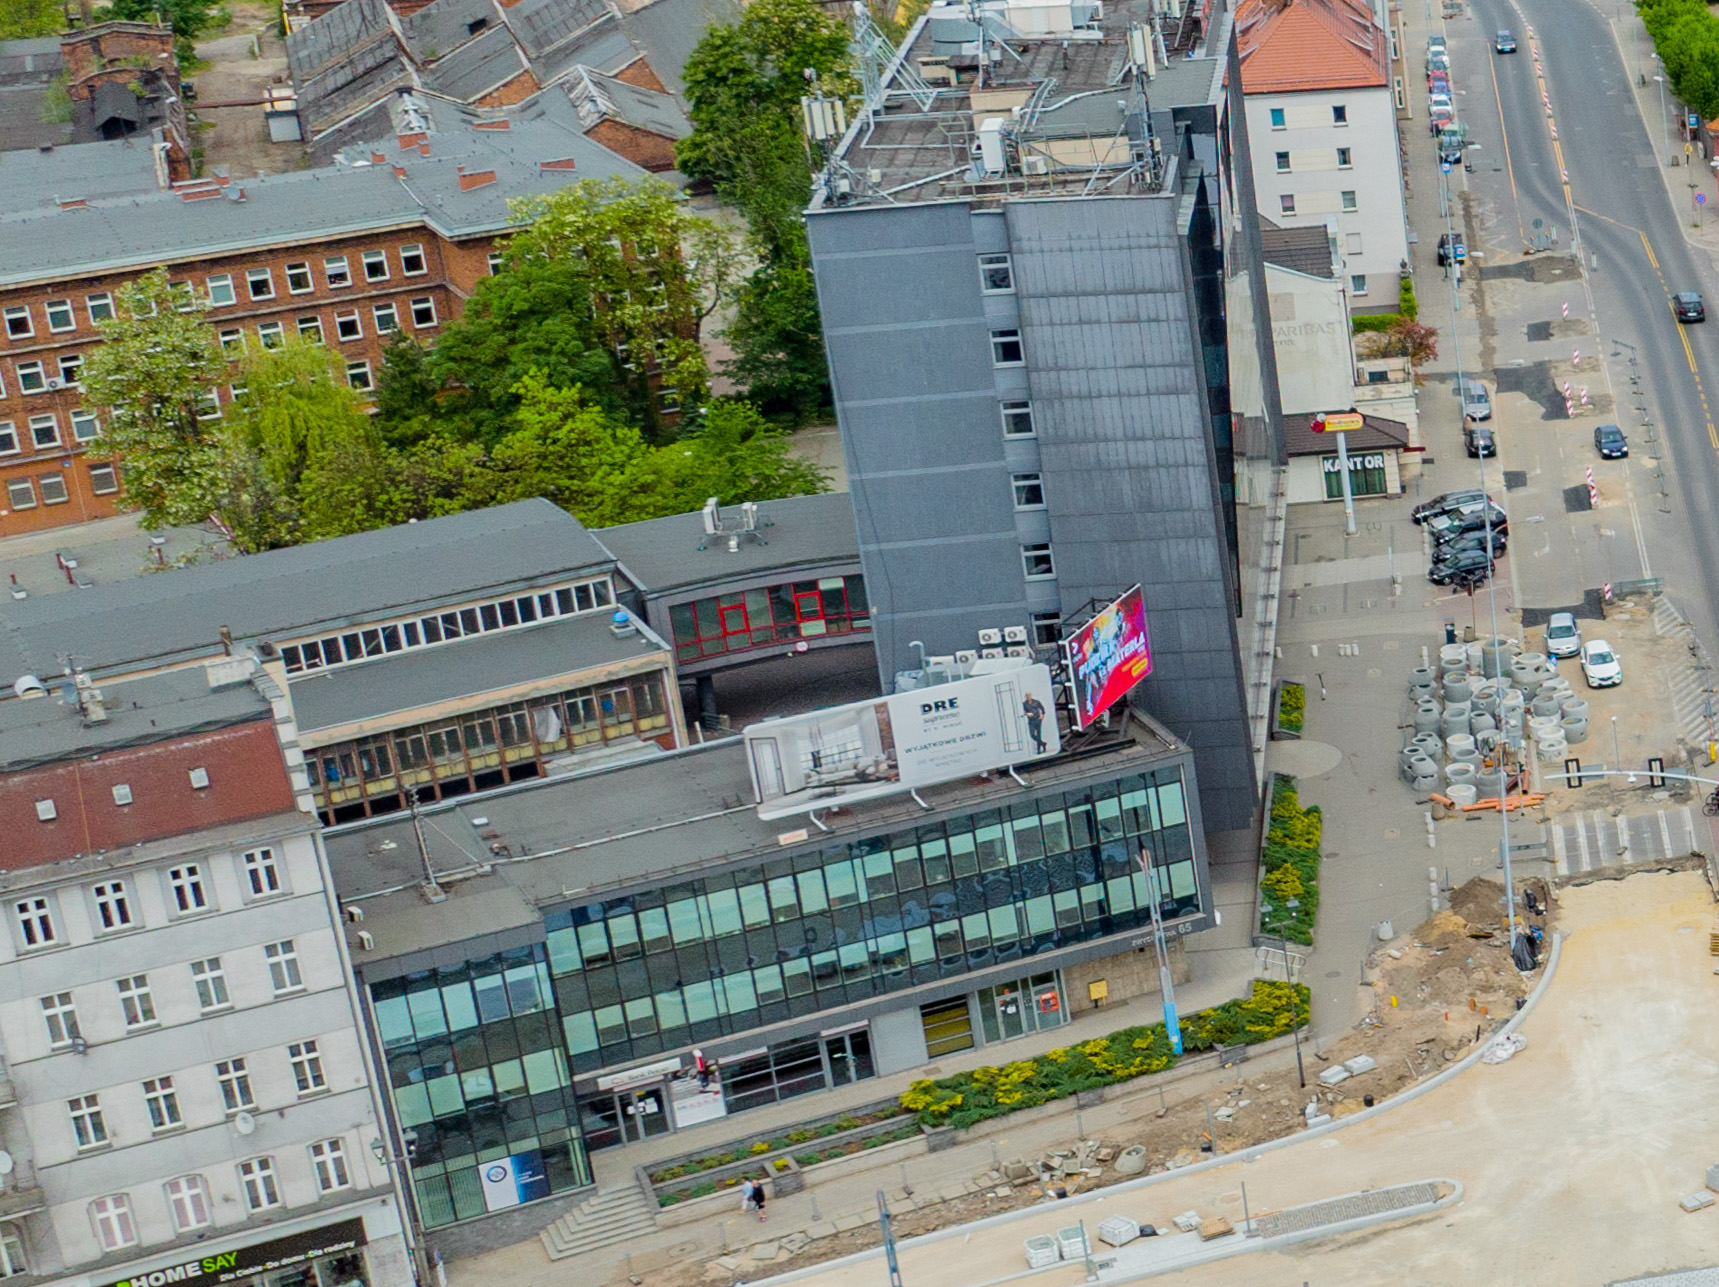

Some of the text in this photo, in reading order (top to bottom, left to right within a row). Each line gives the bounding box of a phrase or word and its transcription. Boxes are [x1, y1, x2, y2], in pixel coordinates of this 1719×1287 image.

[921, 697, 958, 715] DRE
[1179, 923, 1192, 934] 65
[203, 1251, 238, 1274] SAY
